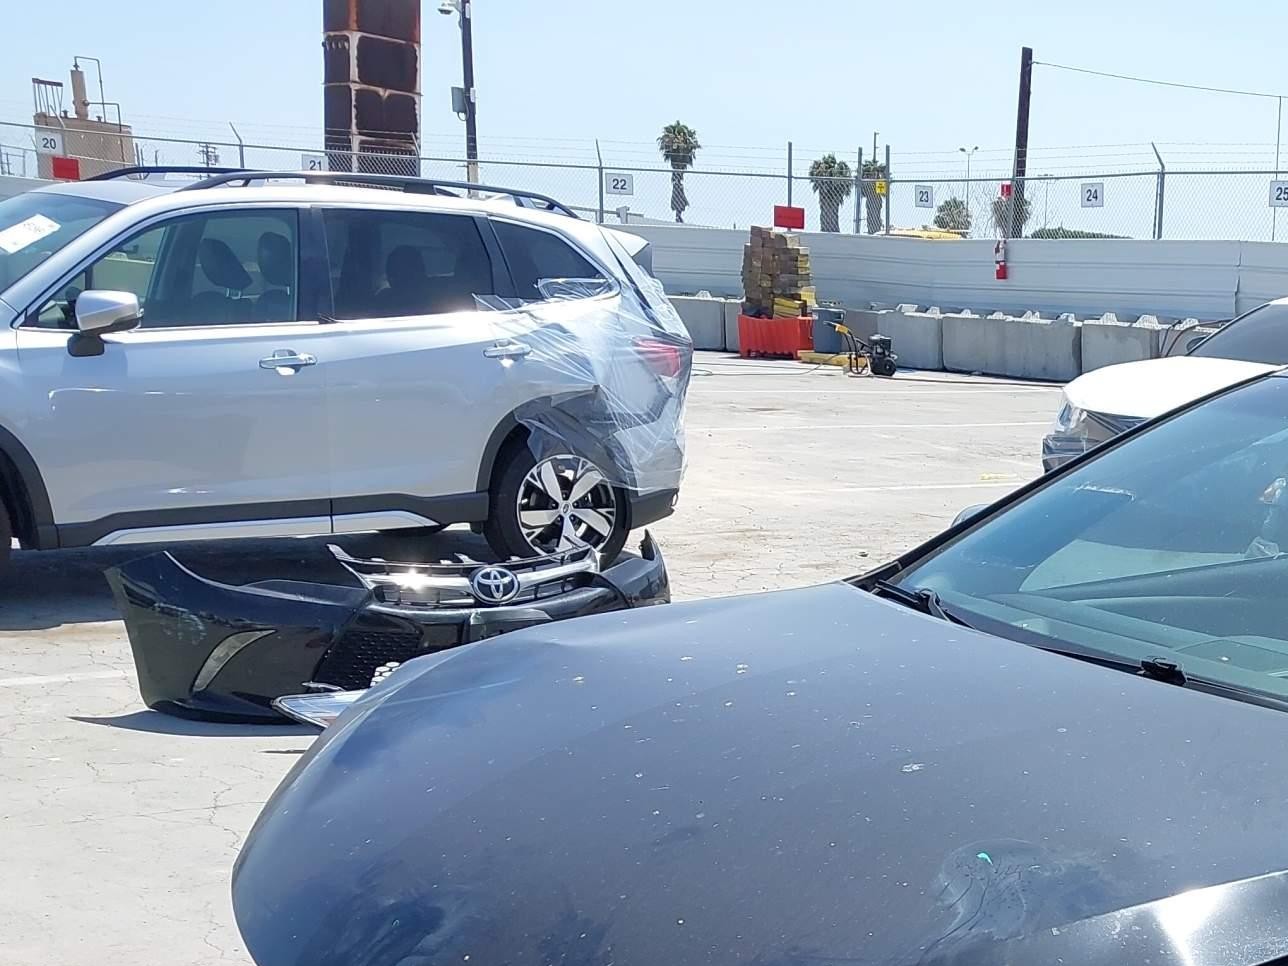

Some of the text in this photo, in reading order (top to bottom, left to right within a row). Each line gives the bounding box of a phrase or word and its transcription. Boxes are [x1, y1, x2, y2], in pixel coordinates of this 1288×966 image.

[42, 137, 57, 151] 20
[310, 160, 322, 171] 21
[612, 179, 627, 190] 22
[919, 190, 929, 203] 23
[1086, 188, 1098, 202] 24
